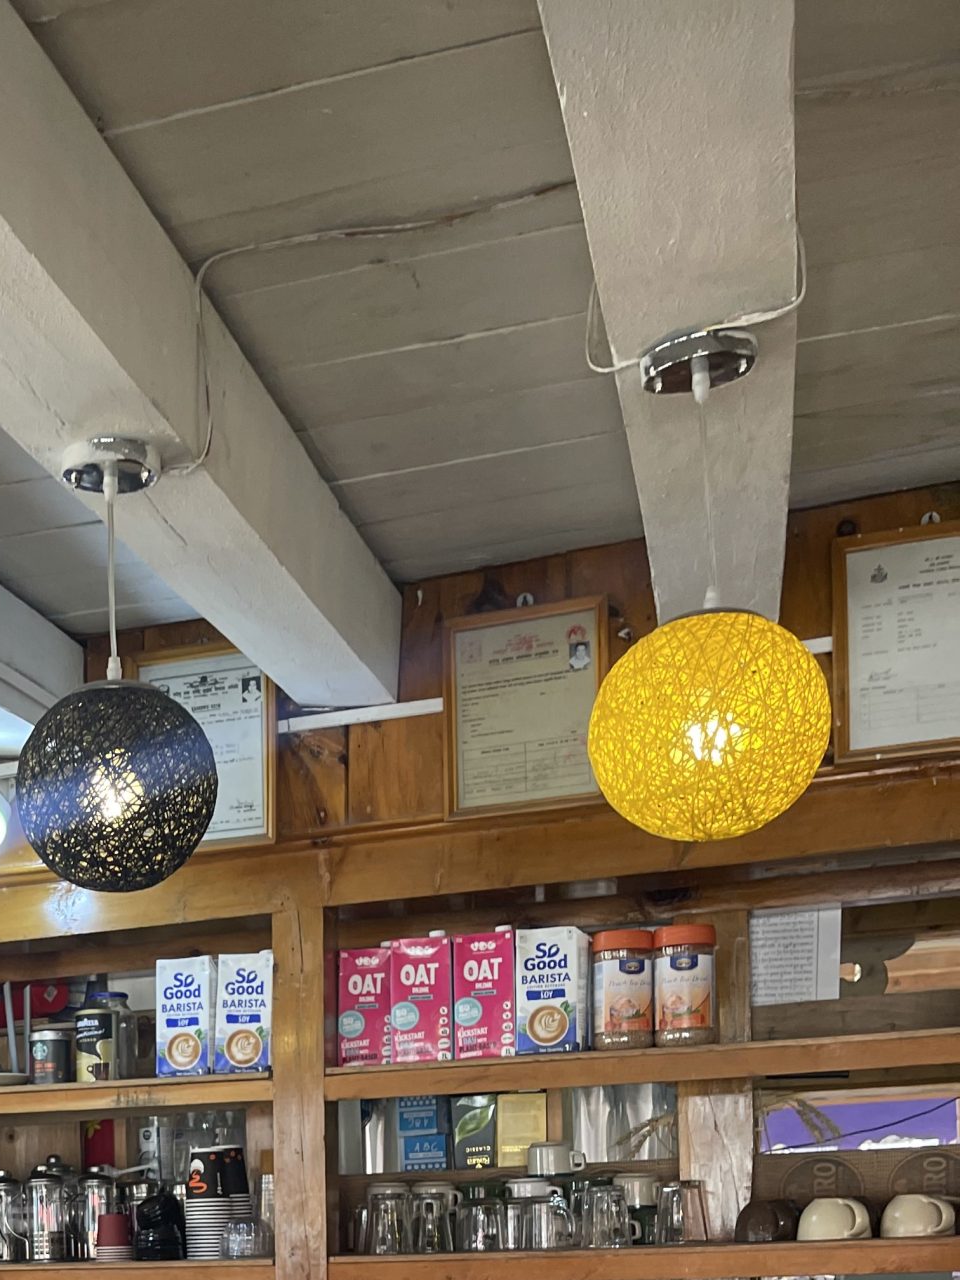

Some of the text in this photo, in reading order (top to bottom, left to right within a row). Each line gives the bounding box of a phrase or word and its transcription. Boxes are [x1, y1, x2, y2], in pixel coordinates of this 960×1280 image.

[463, 958, 502, 981] OAT
[524, 954, 568, 971] Good
[400, 963, 439, 986] OAT
[522, 973, 571, 985] BARISTA
[164, 984, 200, 1000] Good
[225, 981, 264, 995] Good
[348, 973, 385, 995] OAT
[162, 1002, 203, 1013] BARISTA
[222, 999, 266, 1009] BARISTA
